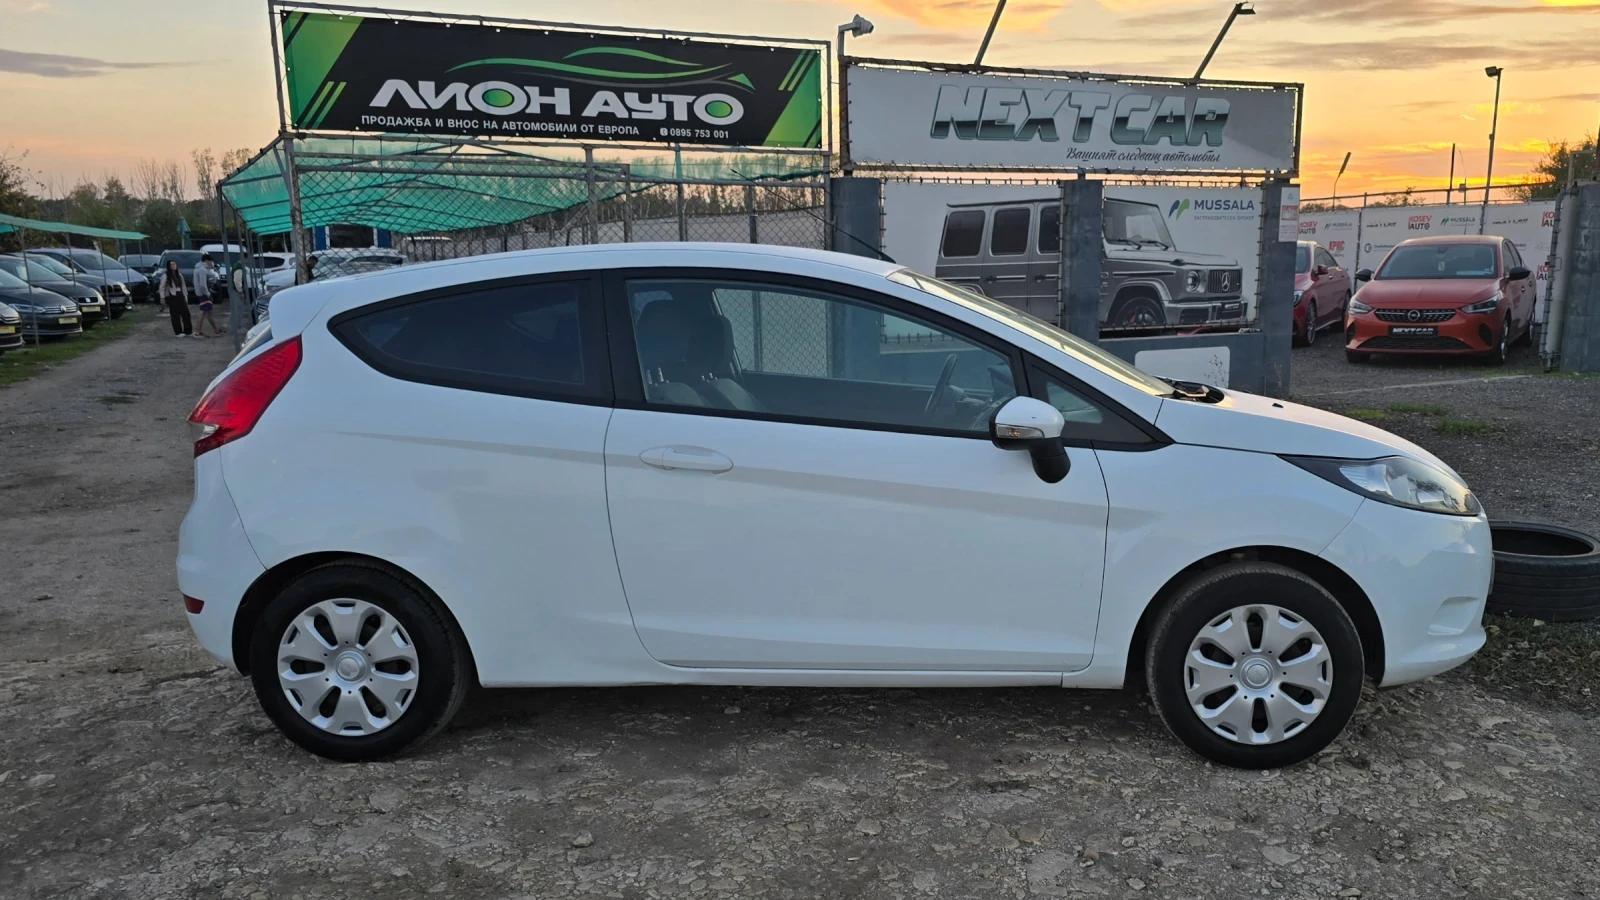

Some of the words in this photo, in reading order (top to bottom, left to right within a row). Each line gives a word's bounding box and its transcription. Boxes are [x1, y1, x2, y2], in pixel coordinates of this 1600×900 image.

[369, 79, 571, 115] ЛИОН
[581, 90, 744, 125] АУТО
[361, 115, 432, 127] ПРОДАЖБА
[435, 118, 444, 127] И
[448, 119, 479, 129] ВНОС
[483, 120, 498, 129] НА
[502, 121, 577, 133] АВТОМОБИЛИ
[580, 124, 594, 133] ОТ
[598, 125, 640, 135] ЕВРОПА
[930, 84, 1231, 146] NEXTCAR
[670, 128, 692, 137] 0895
[695, 129, 710, 138] 753
[713, 130, 729, 139] 001
[1194, 199, 1255, 210] MUSSALA
